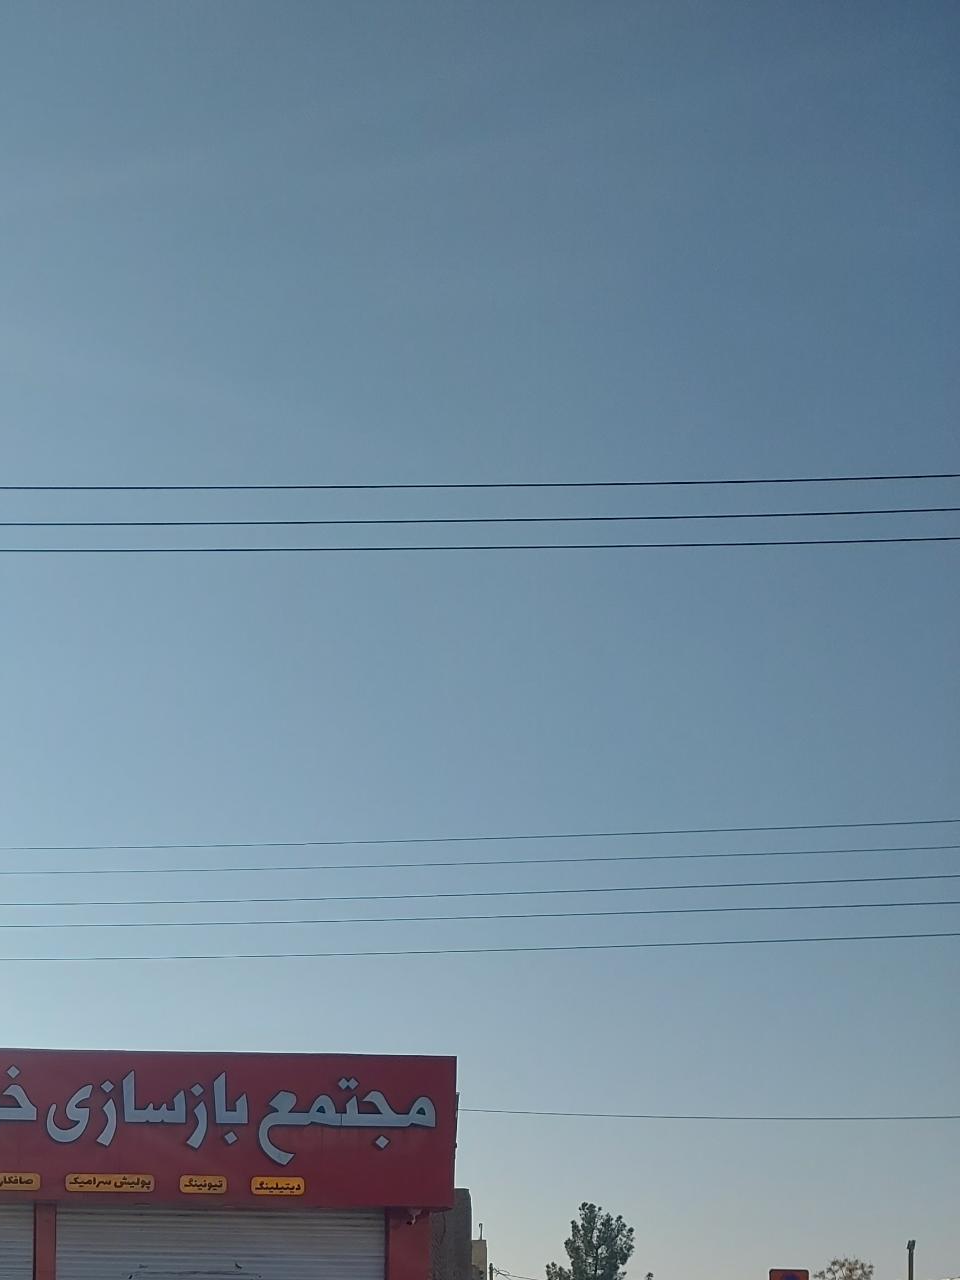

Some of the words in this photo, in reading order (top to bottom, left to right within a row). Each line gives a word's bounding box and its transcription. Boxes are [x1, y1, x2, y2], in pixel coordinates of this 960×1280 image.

[46, 1070, 249, 1149] بازسازی
[257, 1076, 437, 1165] مجتمع
[69, 1176, 112, 1188] سرامیک
[113, 1175, 152, 1190] پولیش
